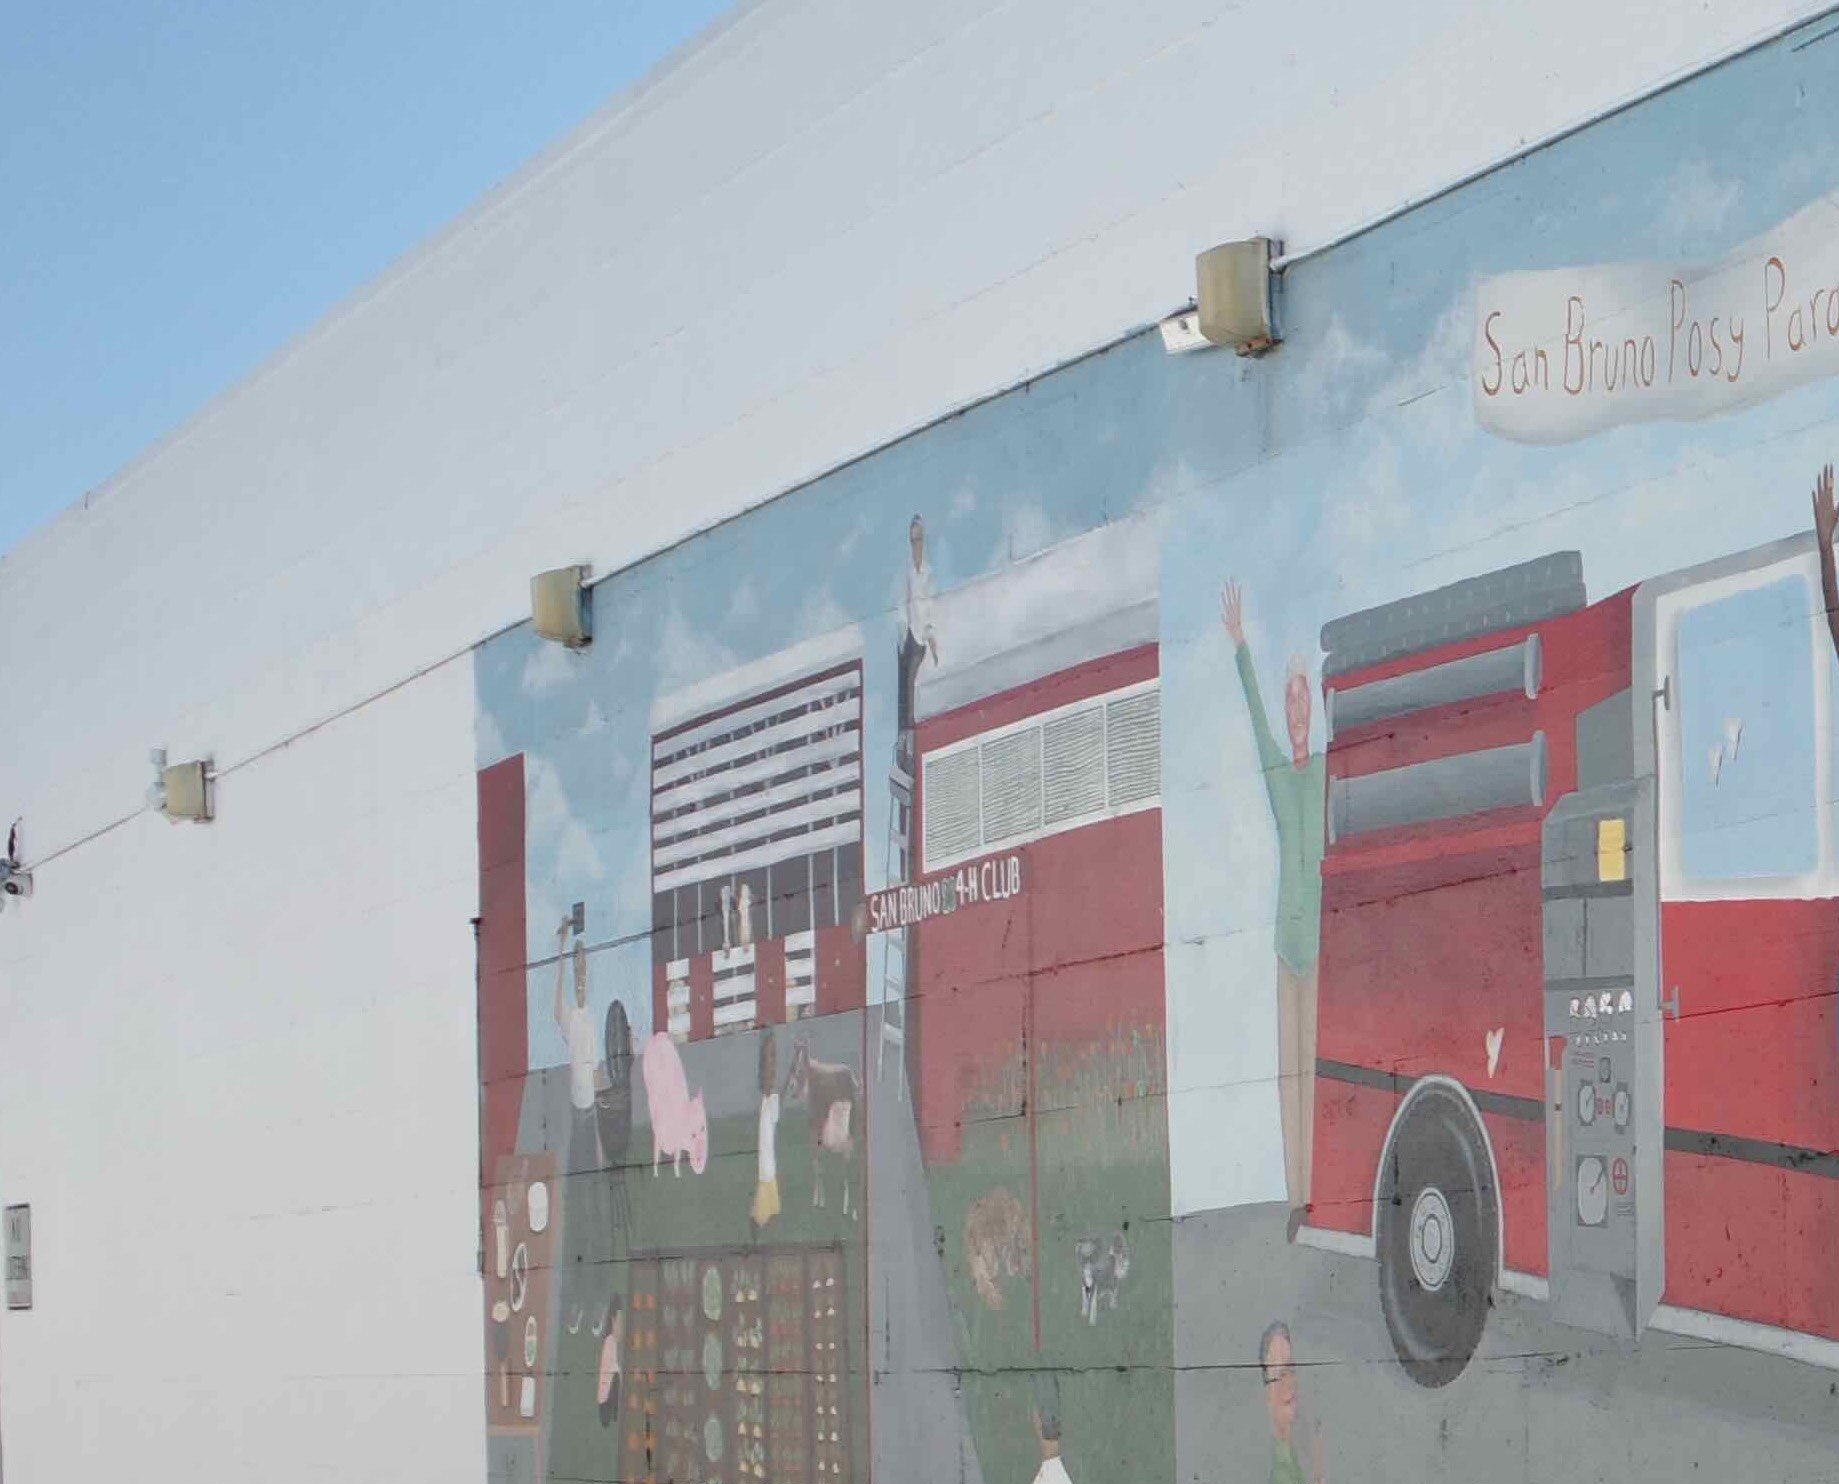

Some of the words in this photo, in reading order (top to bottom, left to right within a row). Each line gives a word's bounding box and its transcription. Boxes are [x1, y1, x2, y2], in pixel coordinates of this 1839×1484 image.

[1482, 311, 1549, 396] San
[1563, 296, 1655, 395] Bruno
[1668, 279, 1745, 383] Posy
[870, 891, 898, 933] SAN
[899, 881, 941, 926] BRUNO
[956, 866, 978, 906] 4-H
[981, 856, 1020, 901] CLUB
